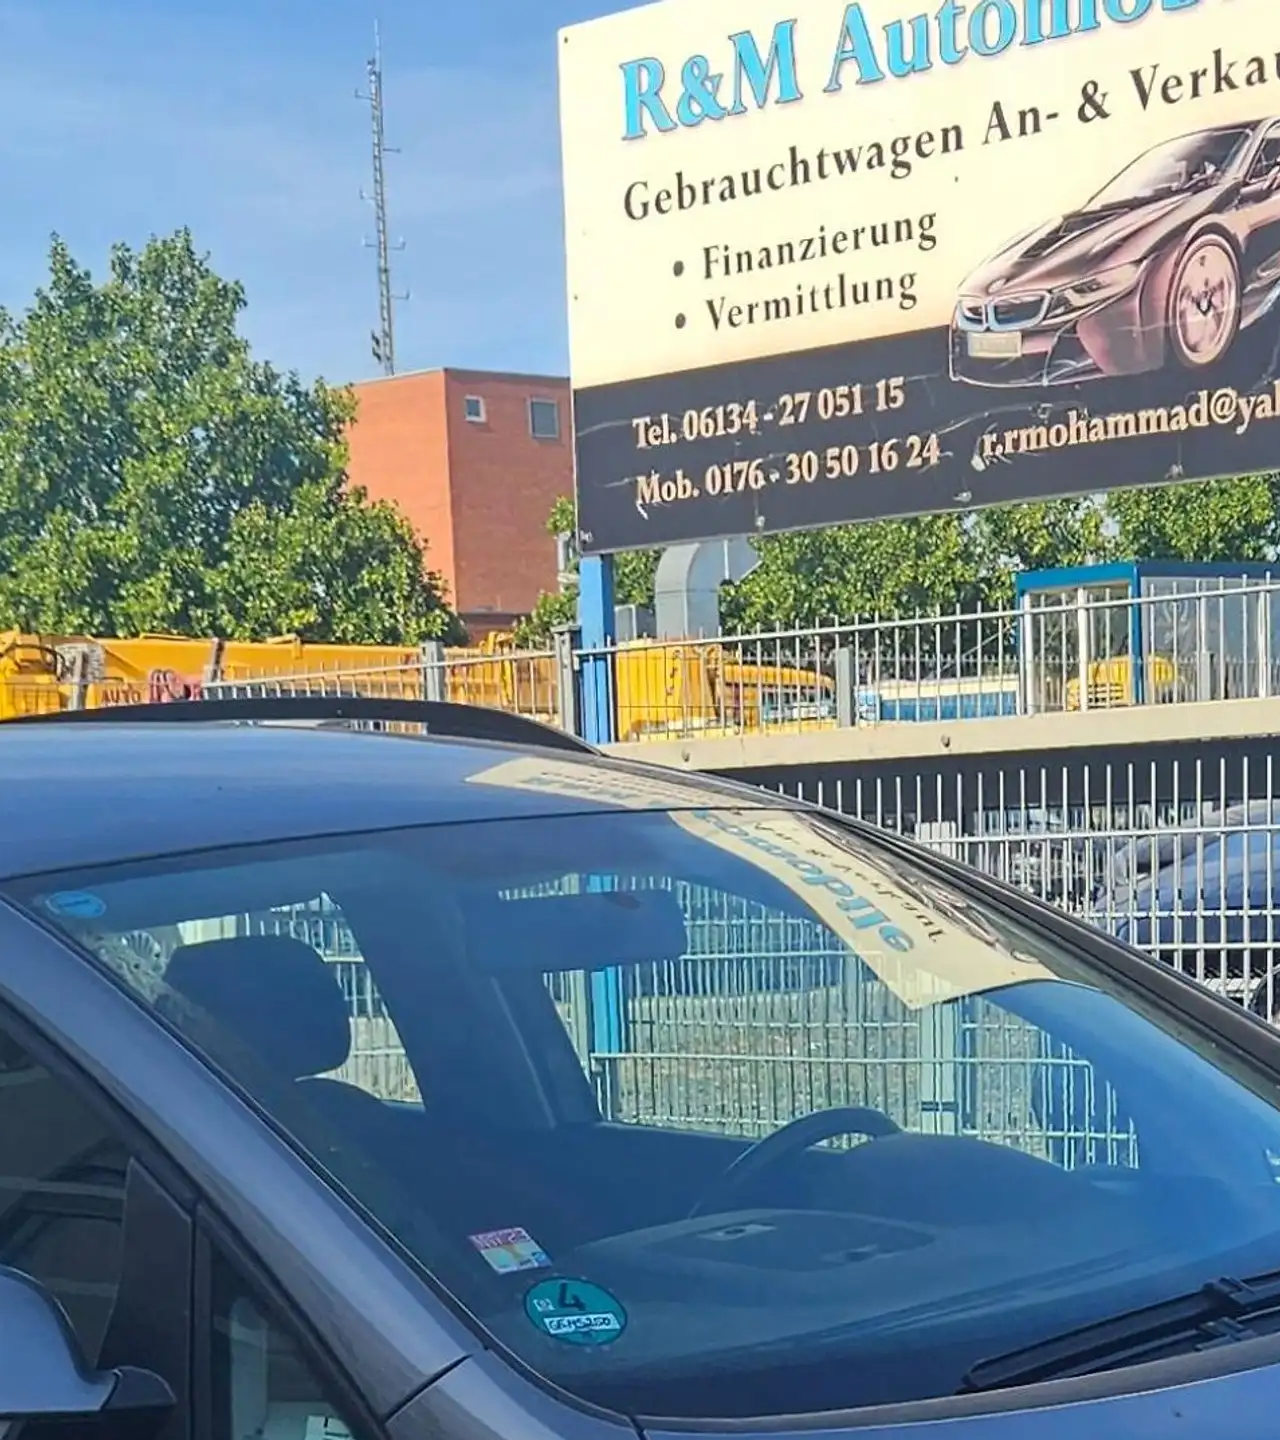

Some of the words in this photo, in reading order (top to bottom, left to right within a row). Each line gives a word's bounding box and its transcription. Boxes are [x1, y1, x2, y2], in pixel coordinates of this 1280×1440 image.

[619, 18, 804, 141] R&M
[624, 123, 965, 221] Gebrauchtwagen
[982, 100, 1059, 145] An-
[1077, 79, 1111, 124] &
[703, 212, 937, 279] Finanzierung
[705, 272, 918, 331] Vermittlung
[632, 412, 677, 449] Tel.
[682, 400, 758, 442] 06134
[779, 391, 811, 426] 27
[818, 383, 862, 420] 051
[875, 376, 904, 412] 15
[635, 468, 700, 505] Mob.
[704, 458, 766, 496] 0176
[785, 450, 818, 485] 30
[825, 442, 858, 479] 50
[868, 438, 899, 474] 16
[906, 433, 940, 469] 24
